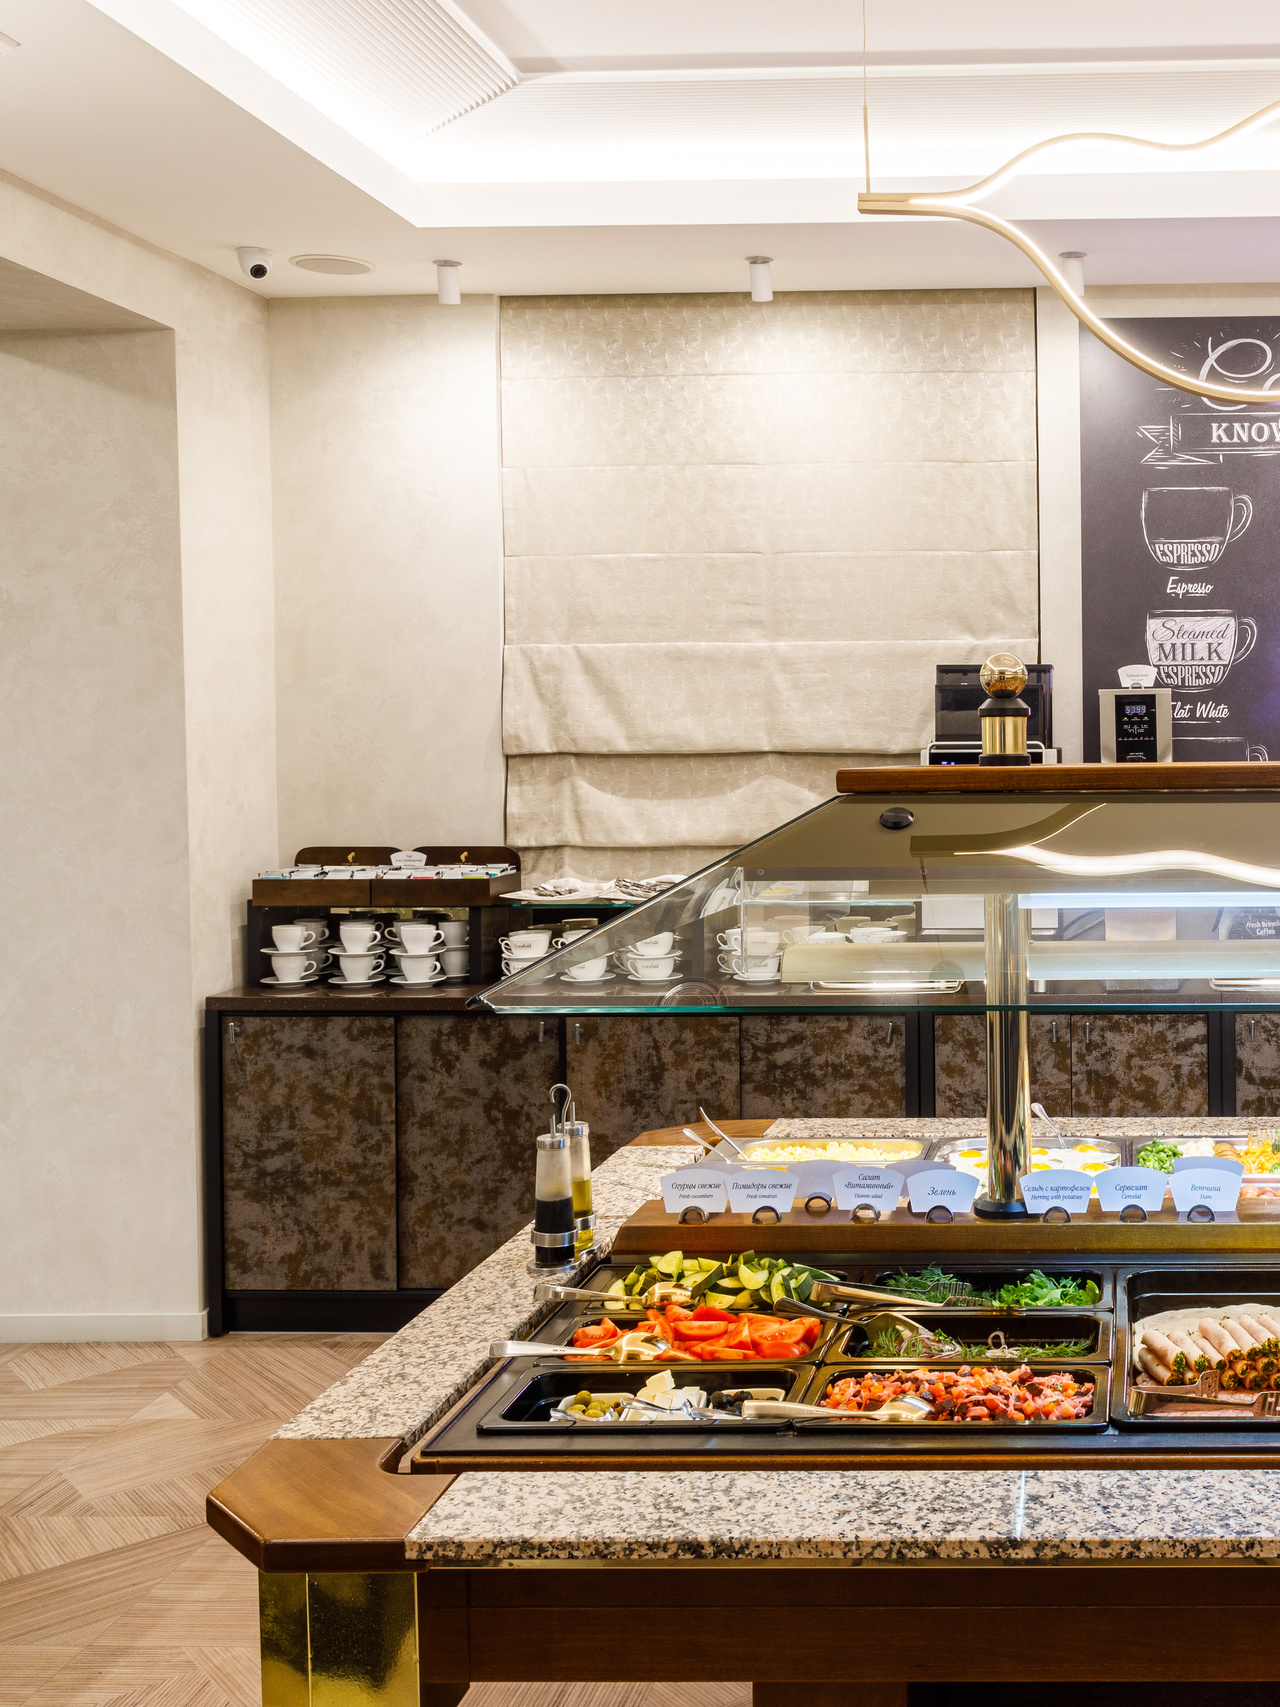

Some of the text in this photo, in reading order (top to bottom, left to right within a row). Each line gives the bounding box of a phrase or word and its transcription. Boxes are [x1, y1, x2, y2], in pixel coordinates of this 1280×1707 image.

[1154, 543, 1220, 565] ESPRESSO
[1166, 576, 1214, 599] Espresso
[1152, 619, 1230, 642] Steamed
[1157, 642, 1225, 662] MILK
[1160, 665, 1224, 686] ESPRESSO
[1196, 701, 1230, 719] White
[858, 1173, 881, 1181] Салат
[671, 1182, 696, 1191] Огурцы
[732, 1182, 766, 1191] Помидоры
[927, 1186, 957, 1196] Зелень
[1050, 1184, 1091, 1193] картофелем
[1114, 1183, 1148, 1193] Сервелат
[1190, 1184, 1221, 1192] Ветчина
